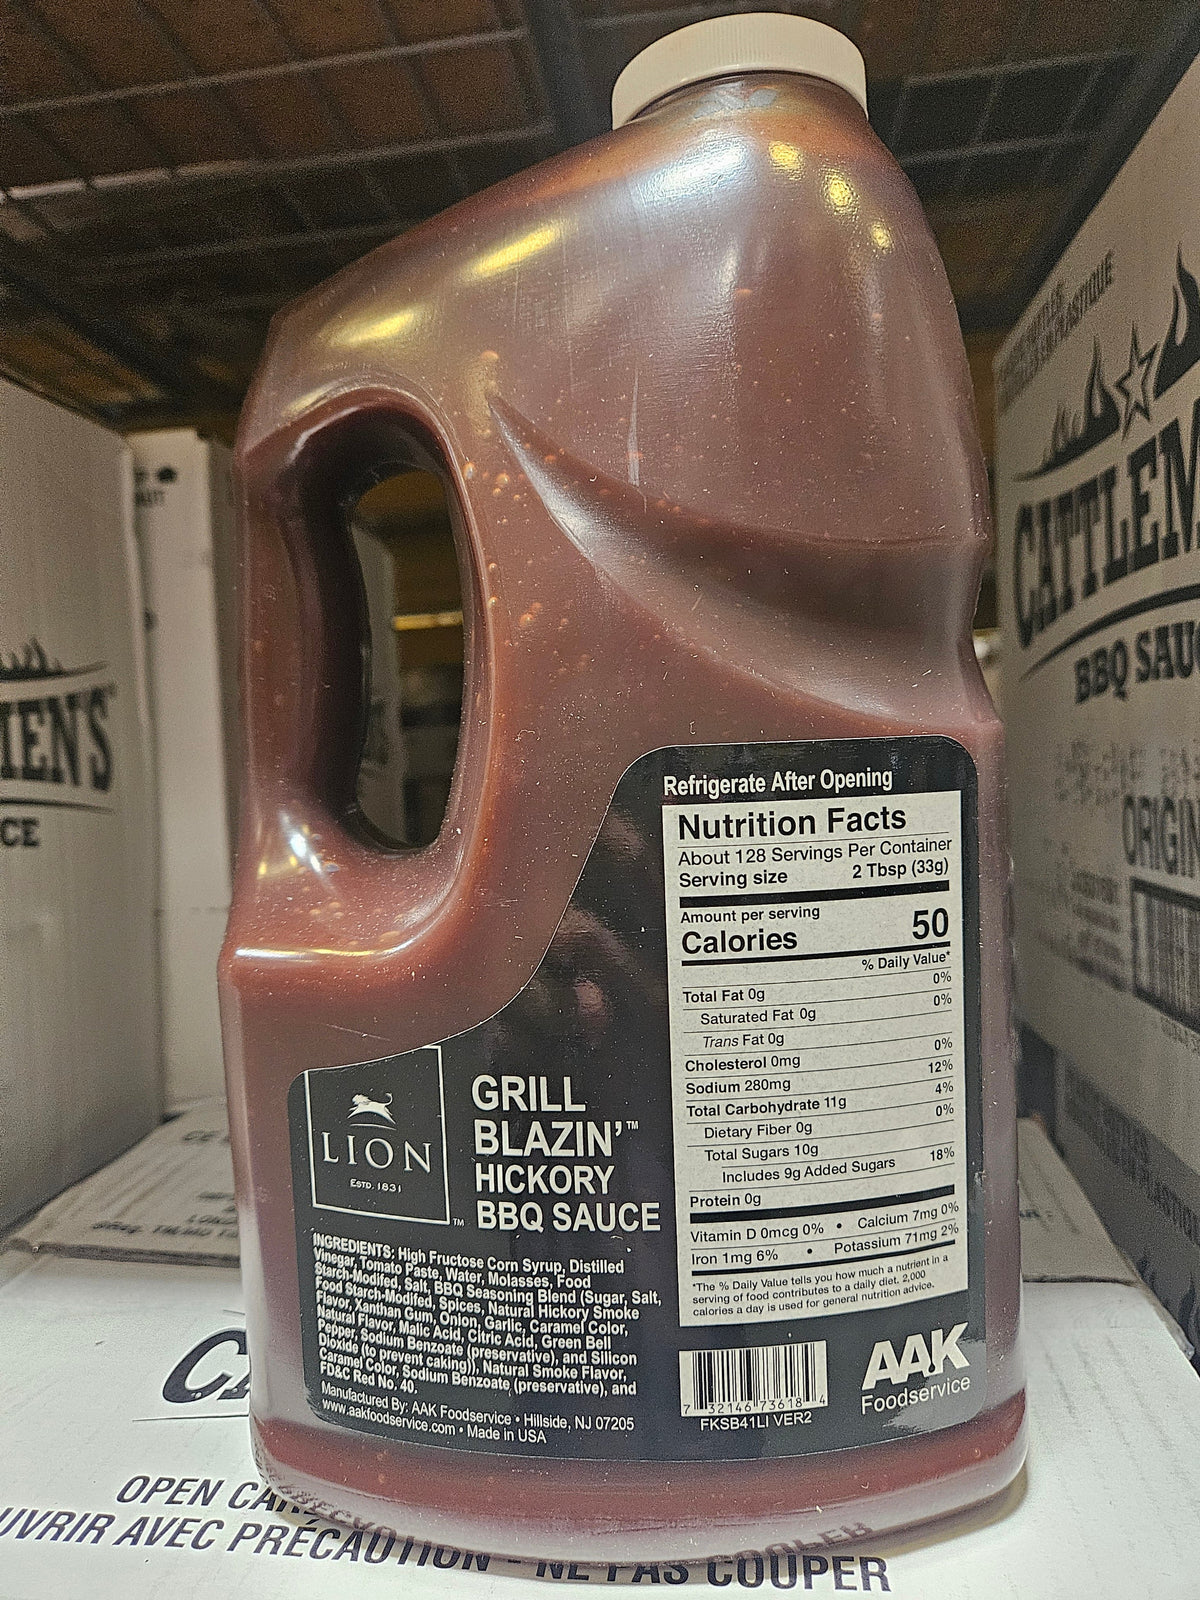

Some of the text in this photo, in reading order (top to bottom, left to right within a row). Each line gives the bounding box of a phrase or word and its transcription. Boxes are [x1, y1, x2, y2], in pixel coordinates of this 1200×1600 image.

[1075, 637, 1128, 704] BBQ
[663, 768, 892, 799] Refrigerate After Opening
[678, 806, 906, 840] Nutrition Facts
[678, 839, 952, 866] About 128 Servings Per Container
[679, 858, 949, 888] Serving size 2 Tbsp (33g)
[680, 907, 820, 924] Amount per serving
[682, 908, 949, 955] Calories 50
[862, 959, 874, 970] %
[878, 954, 909, 970] Daily
[683, 972, 951, 1003] Total Fat 0g 0%
[700, 994, 951, 1025] Saturated Fat 0g 0%
[685, 1037, 952, 1073] Cholesterol 0mg 0%
[703, 1033, 784, 1047] Trans Fat 0g
[472, 1074, 586, 1112] GRILL
[686, 1060, 953, 1094] Sodium 280mg 12%
[686, 1081, 954, 1117] Total Carbohydrate 11g 4%
[704, 1104, 954, 1140] Dietary Fiber 0g 0%
[322, 1132, 431, 1174] LION
[705, 1144, 819, 1161] Total Sugars 10g
[722, 1147, 955, 1183] Includes 9g Added Sugars 18%
[378, 1180, 401, 1193] 1831
[475, 1164, 615, 1194] HICKORY
[477, 1201, 661, 1232] BBQ SAUCE
[690, 1194, 761, 1208] Protein 0g
[690, 1202, 959, 1243] Vitamin D 0mcg 0% Calcium 7mg 0%
[313, 1233, 624, 1275] INGREDIENTS: High Fructose Corn Syrup, Distilled
[692, 1223, 959, 1265] Iron 1mg 6% Potassium 71mg 2%
[314, 1247, 591, 1289] Vinegar, Tomato Paste, Water, Molasses, Food
[719, 1281, 729, 1291] %
[732, 1279, 758, 1292] Daily
[762, 1278, 788, 1288] Value
[791, 1275, 812, 1286] tells
[815, 1275, 833, 1285] you
[836, 1270, 856, 1281] how
[859, 1266, 884, 1279] much
[896, 1258, 929, 1273] nutrient
[932, 1256, 940, 1265] in
[404, 1278, 431, 1295] Salt,
[434, 1281, 463, 1298] BBQ
[466, 1284, 533, 1305] Seasoning
[538, 1289, 576, 1304] Blend
[580, 1290, 628, 1307] (Sugar,
[632, 1290, 661, 1307] Salt,
[861, 1322, 970, 1390] AAK
[320, 1361, 418, 1394] FD&C Red No. 40.
[322, 1381, 634, 1431] Manufactured By: AAK Foodservice Hillside, NJ 07205
[861, 1376, 970, 1414] Foodservice
[322, 1399, 546, 1444] www.aakfoodservice.com Made in USA
[700, 1412, 812, 1431] FKSB41LI VER2
[117, 1475, 224, 1505] OPEN
[112, 1516, 225, 1550] AVEC
[707, 1553, 892, 1593] COUPER
